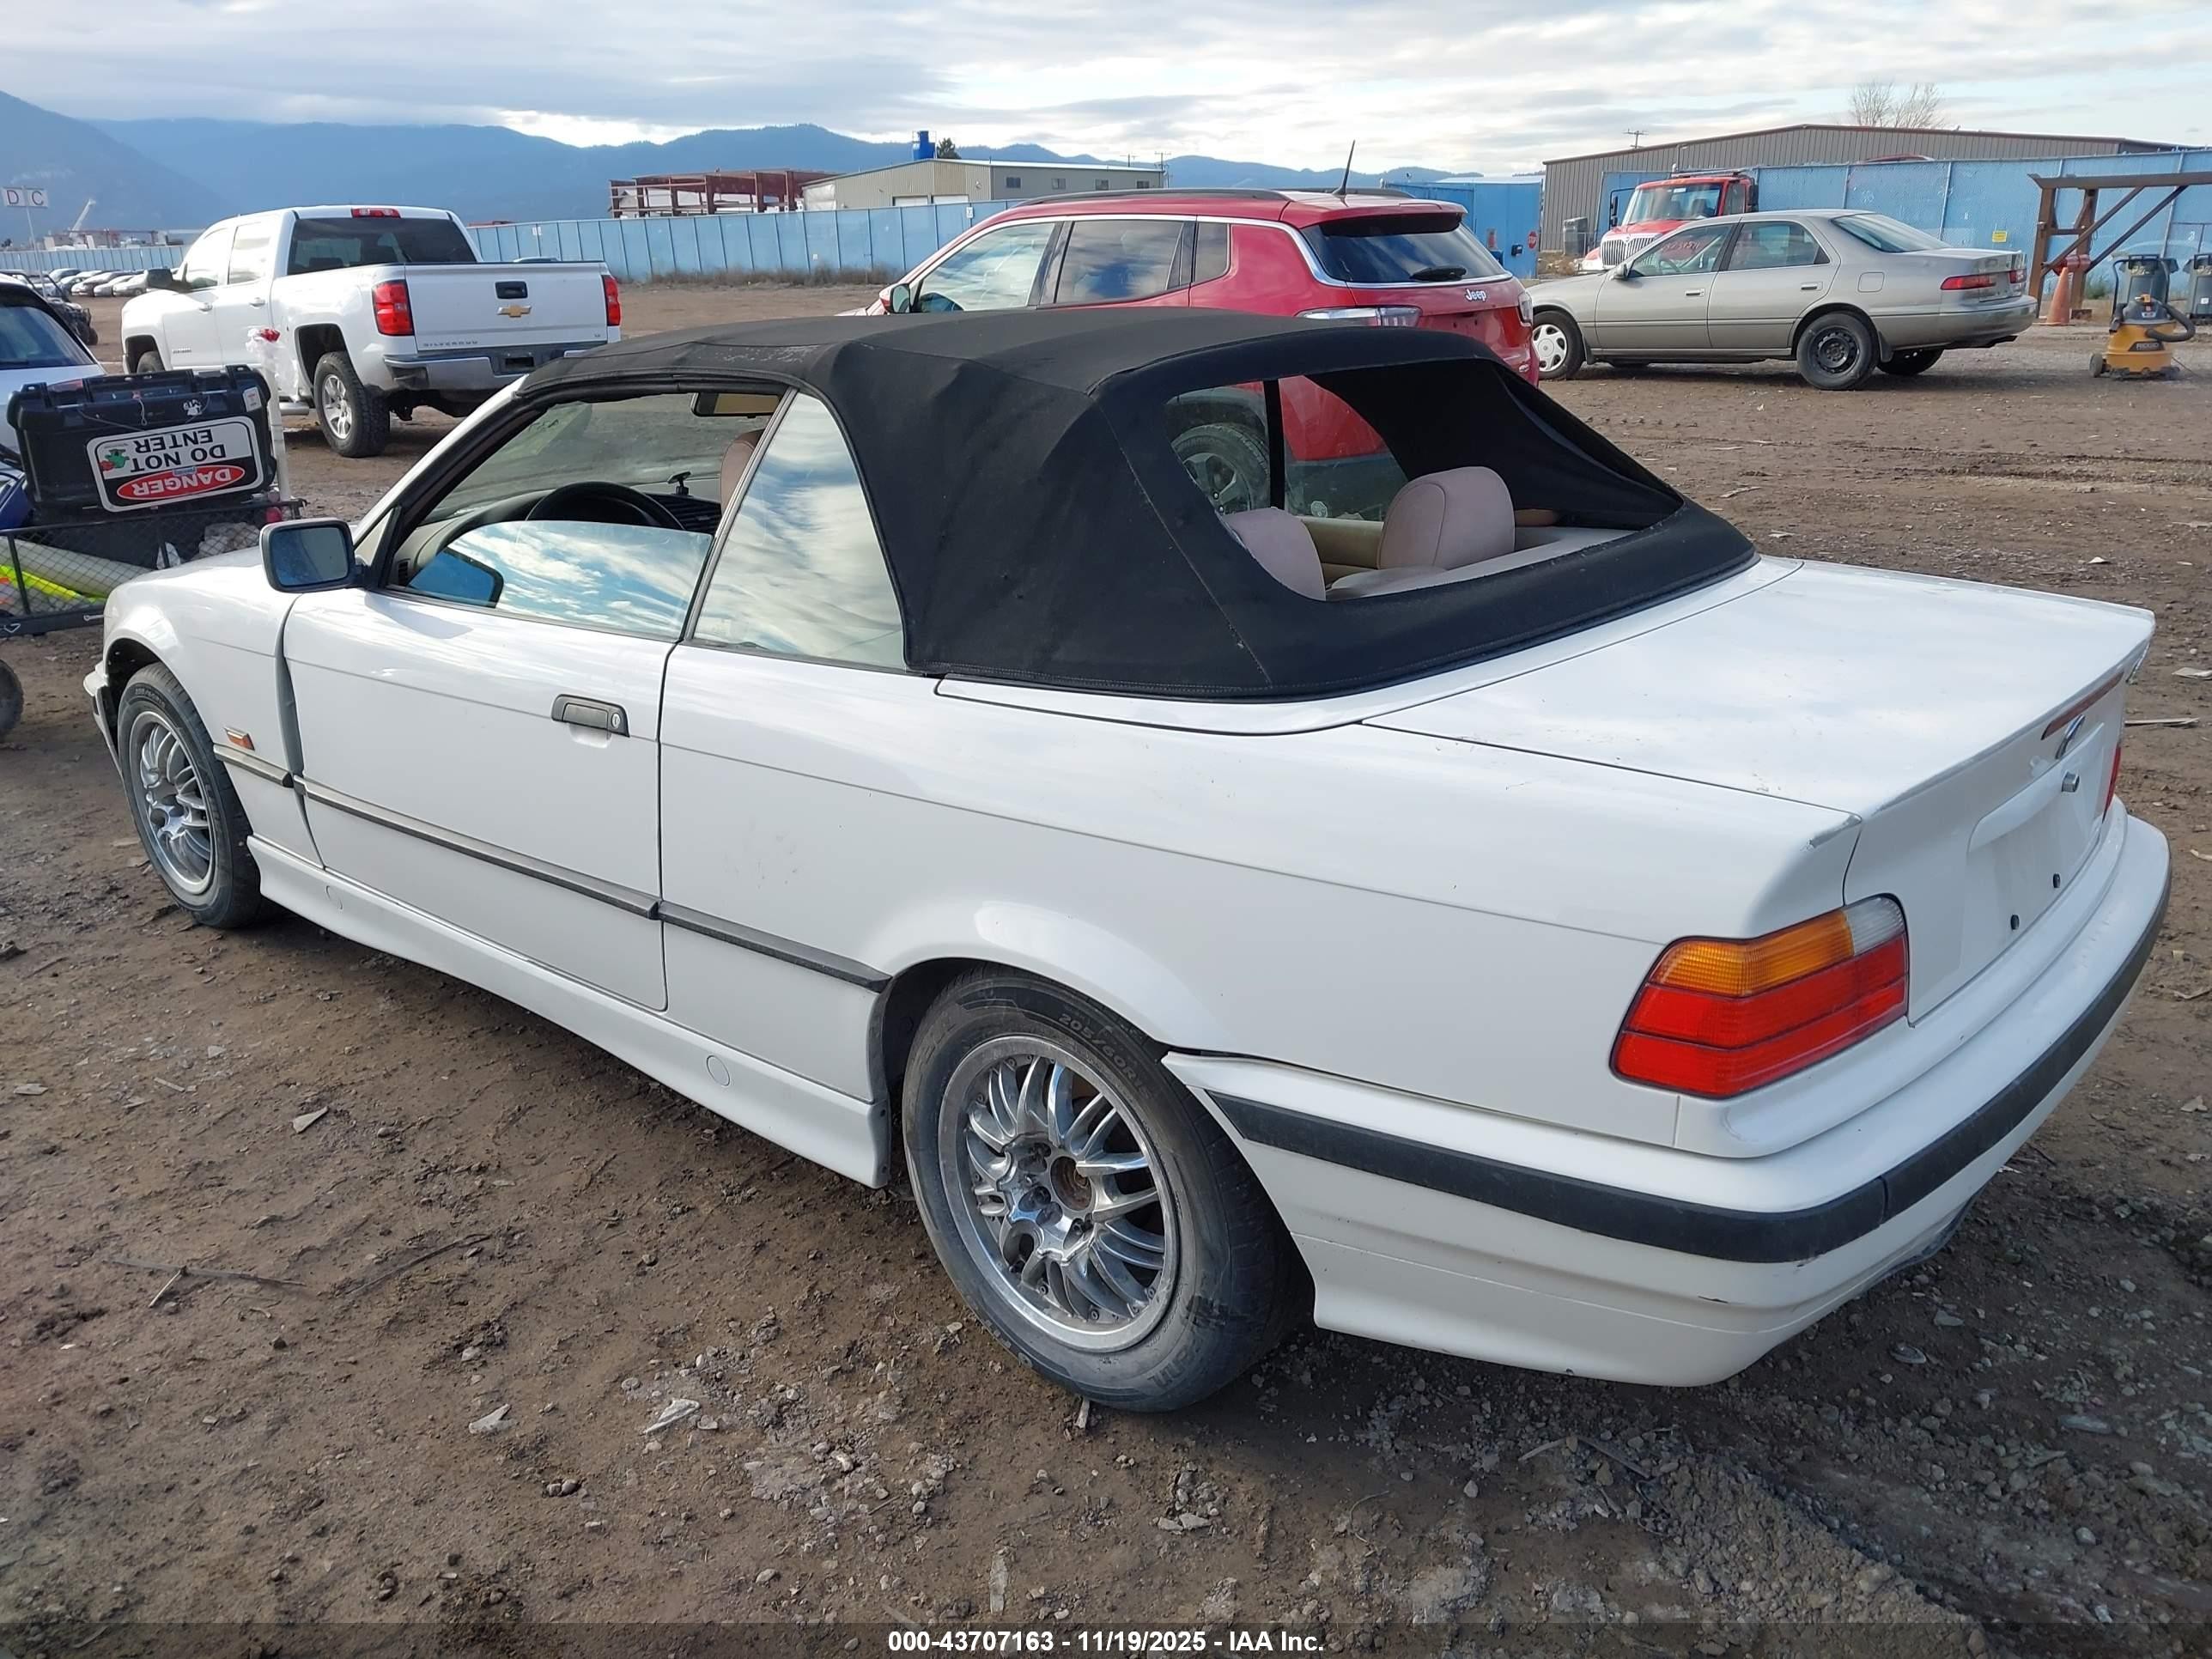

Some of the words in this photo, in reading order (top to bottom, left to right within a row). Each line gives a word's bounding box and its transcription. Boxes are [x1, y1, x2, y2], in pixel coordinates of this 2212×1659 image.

[7, 190, 20, 204] D
[31, 191, 44, 206] C
[1465, 289, 1487, 302] Jeep
[133, 428, 214, 454] ENTER
[130, 451, 182, 473] NOT
[191, 443, 227, 463] DO
[132, 468, 233, 496] DANGER
